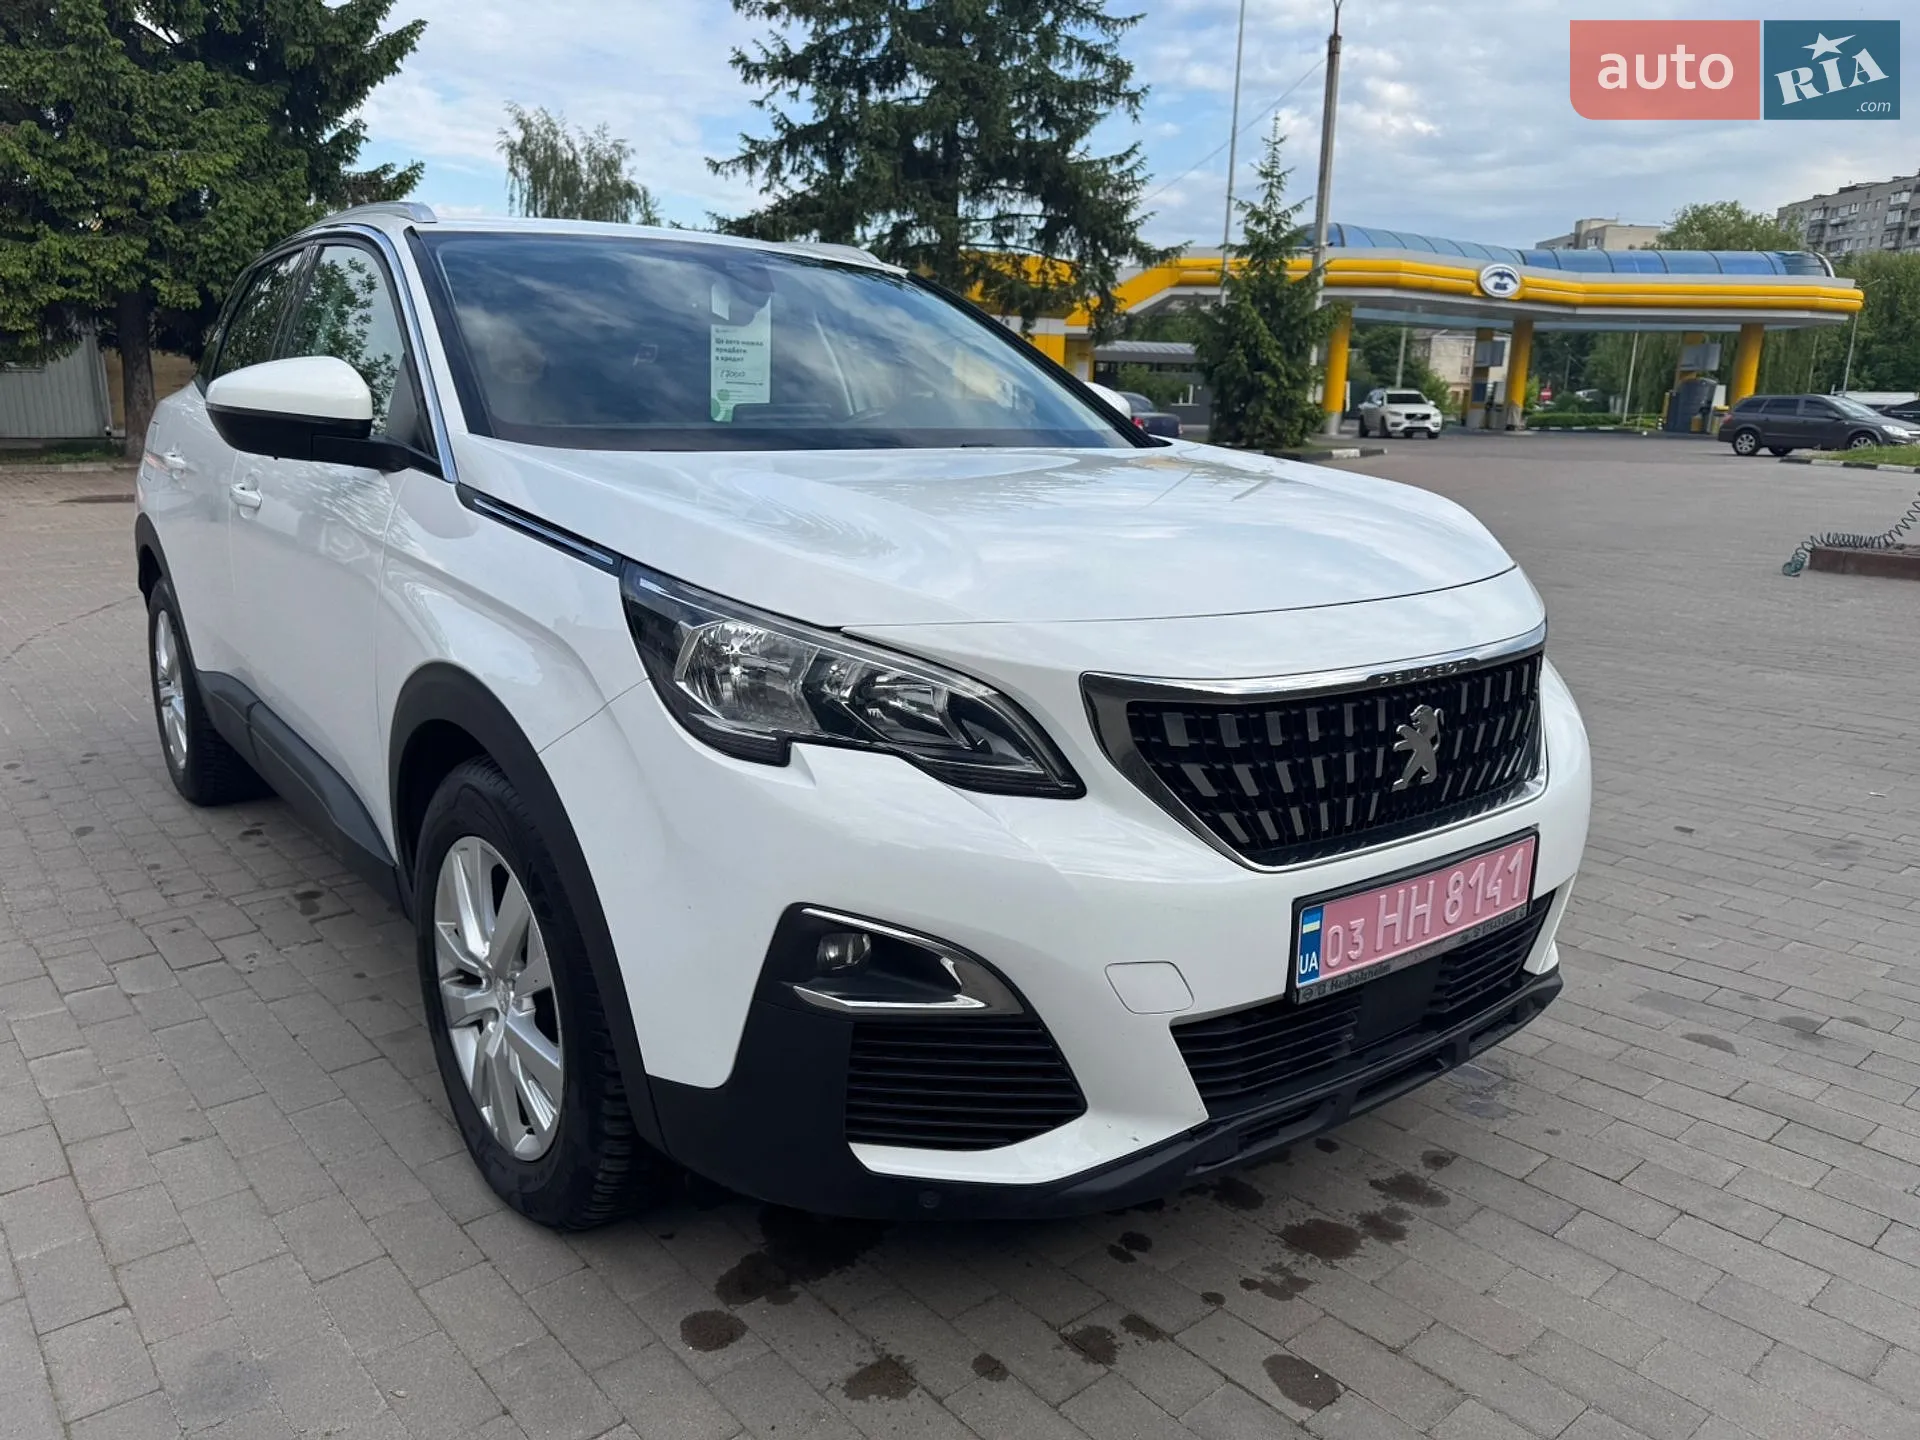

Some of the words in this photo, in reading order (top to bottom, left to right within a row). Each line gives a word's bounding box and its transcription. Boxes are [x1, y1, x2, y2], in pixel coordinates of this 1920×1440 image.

[1300, 951, 1319, 974] UA
[1326, 918, 1365, 968] 03
[1375, 880, 1435, 951] HH
[1444, 847, 1525, 925] 8141
